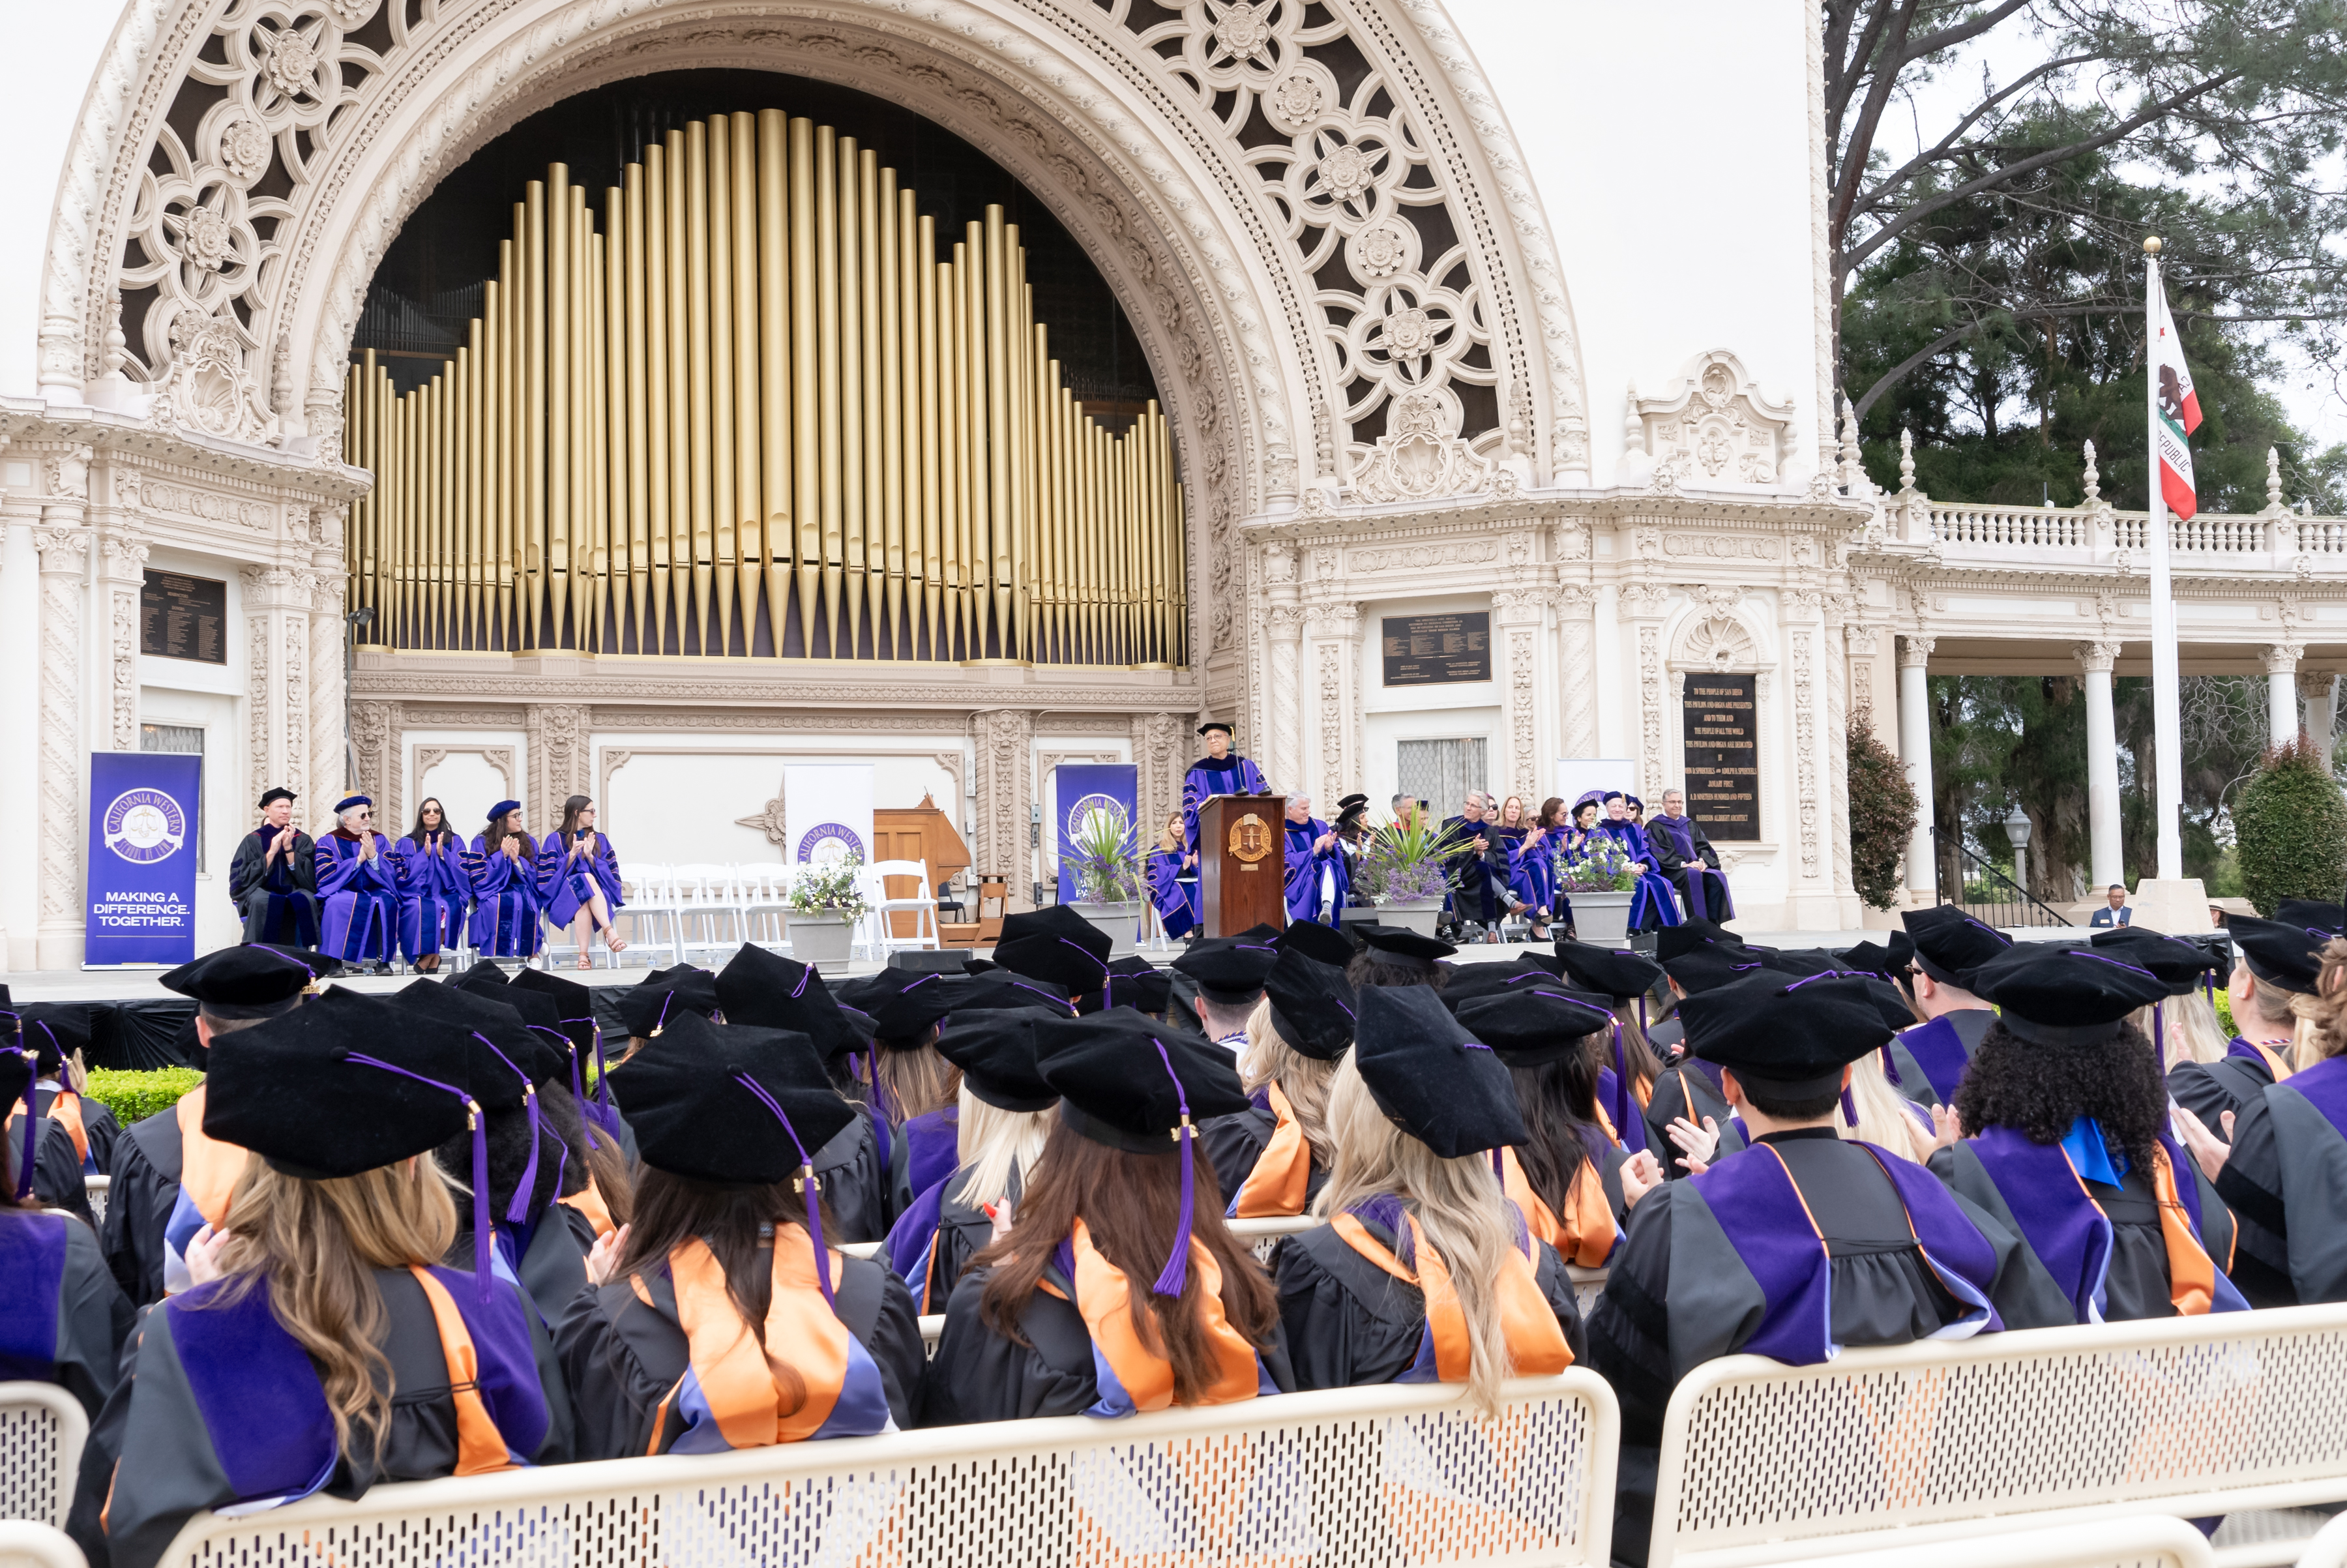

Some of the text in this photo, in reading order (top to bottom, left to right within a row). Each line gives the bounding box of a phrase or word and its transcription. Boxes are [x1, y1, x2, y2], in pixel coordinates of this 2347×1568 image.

[109, 793, 180, 833] CALIFORNIA WESTERN
[117, 840, 171, 860] SCHOOL OF LAW
[799, 825, 836, 860] ALIFORNIA
[106, 892, 179, 902] MAKING A
[93, 904, 190, 915] DIFFERENCE.
[99, 916, 184, 926] TOGETHER.
